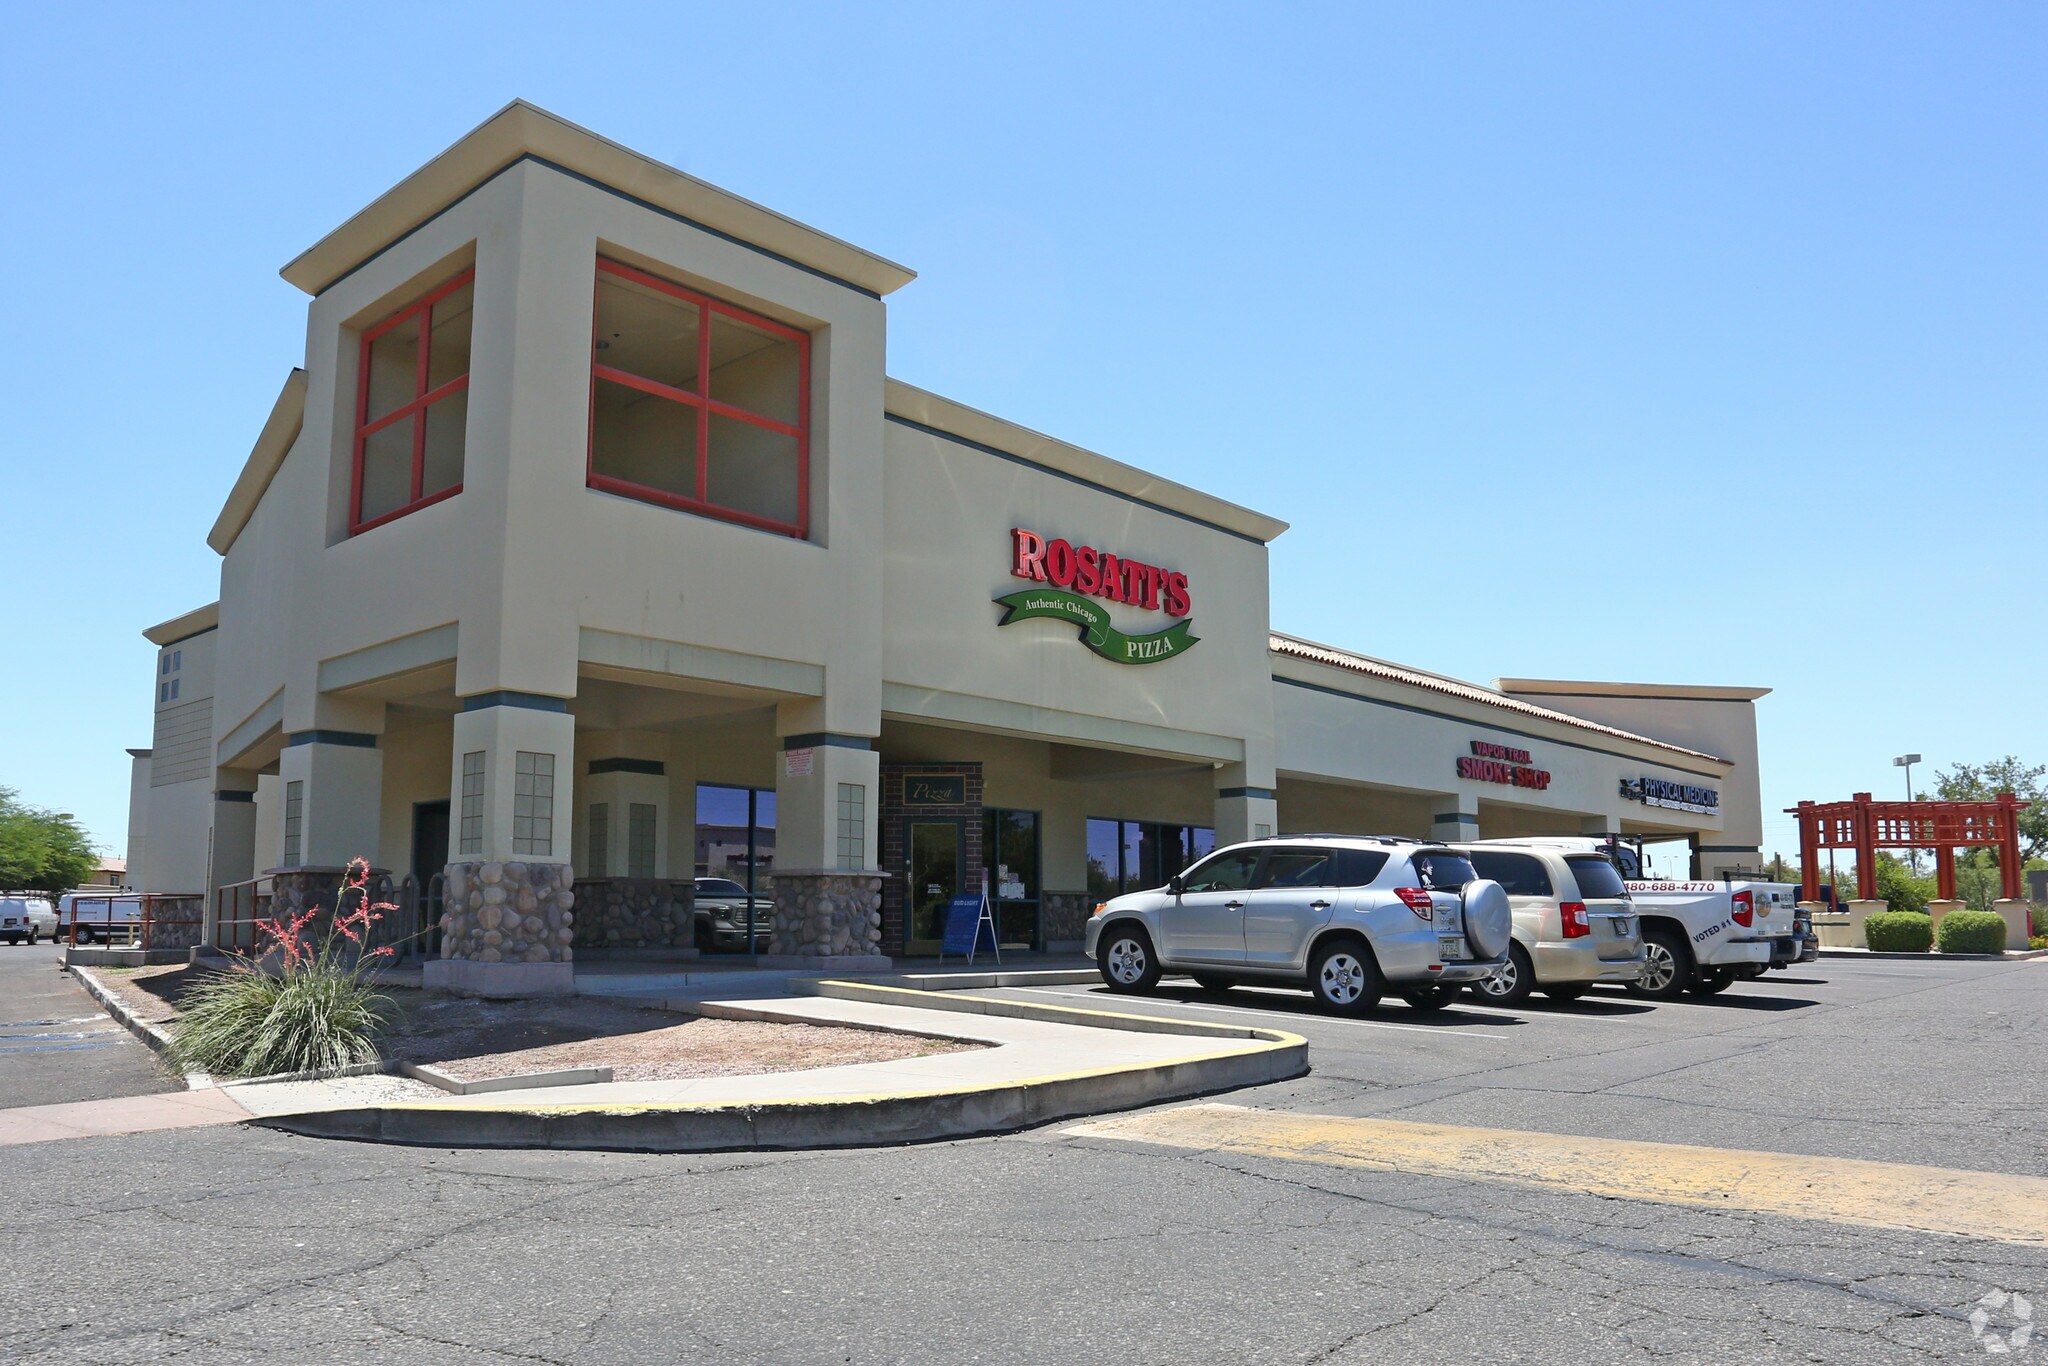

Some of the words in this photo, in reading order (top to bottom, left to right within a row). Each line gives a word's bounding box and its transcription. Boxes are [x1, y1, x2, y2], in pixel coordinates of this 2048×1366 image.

[1011, 528, 1191, 616] ROSATI'S
[1025, 598, 1064, 610] Authentic
[1066, 601, 1098, 623] Chicago
[1126, 636, 1173, 659] PIZZA
[1471, 741, 1506, 760] VAPOR
[1458, 757, 1512, 784] SMOKE
[1512, 766, 1551, 790] SHOP
[913, 783, 952, 801] Pizza
[1643, 778, 1683, 800] PHYSICAL
[1693, 925, 1720, 943] VOTED
